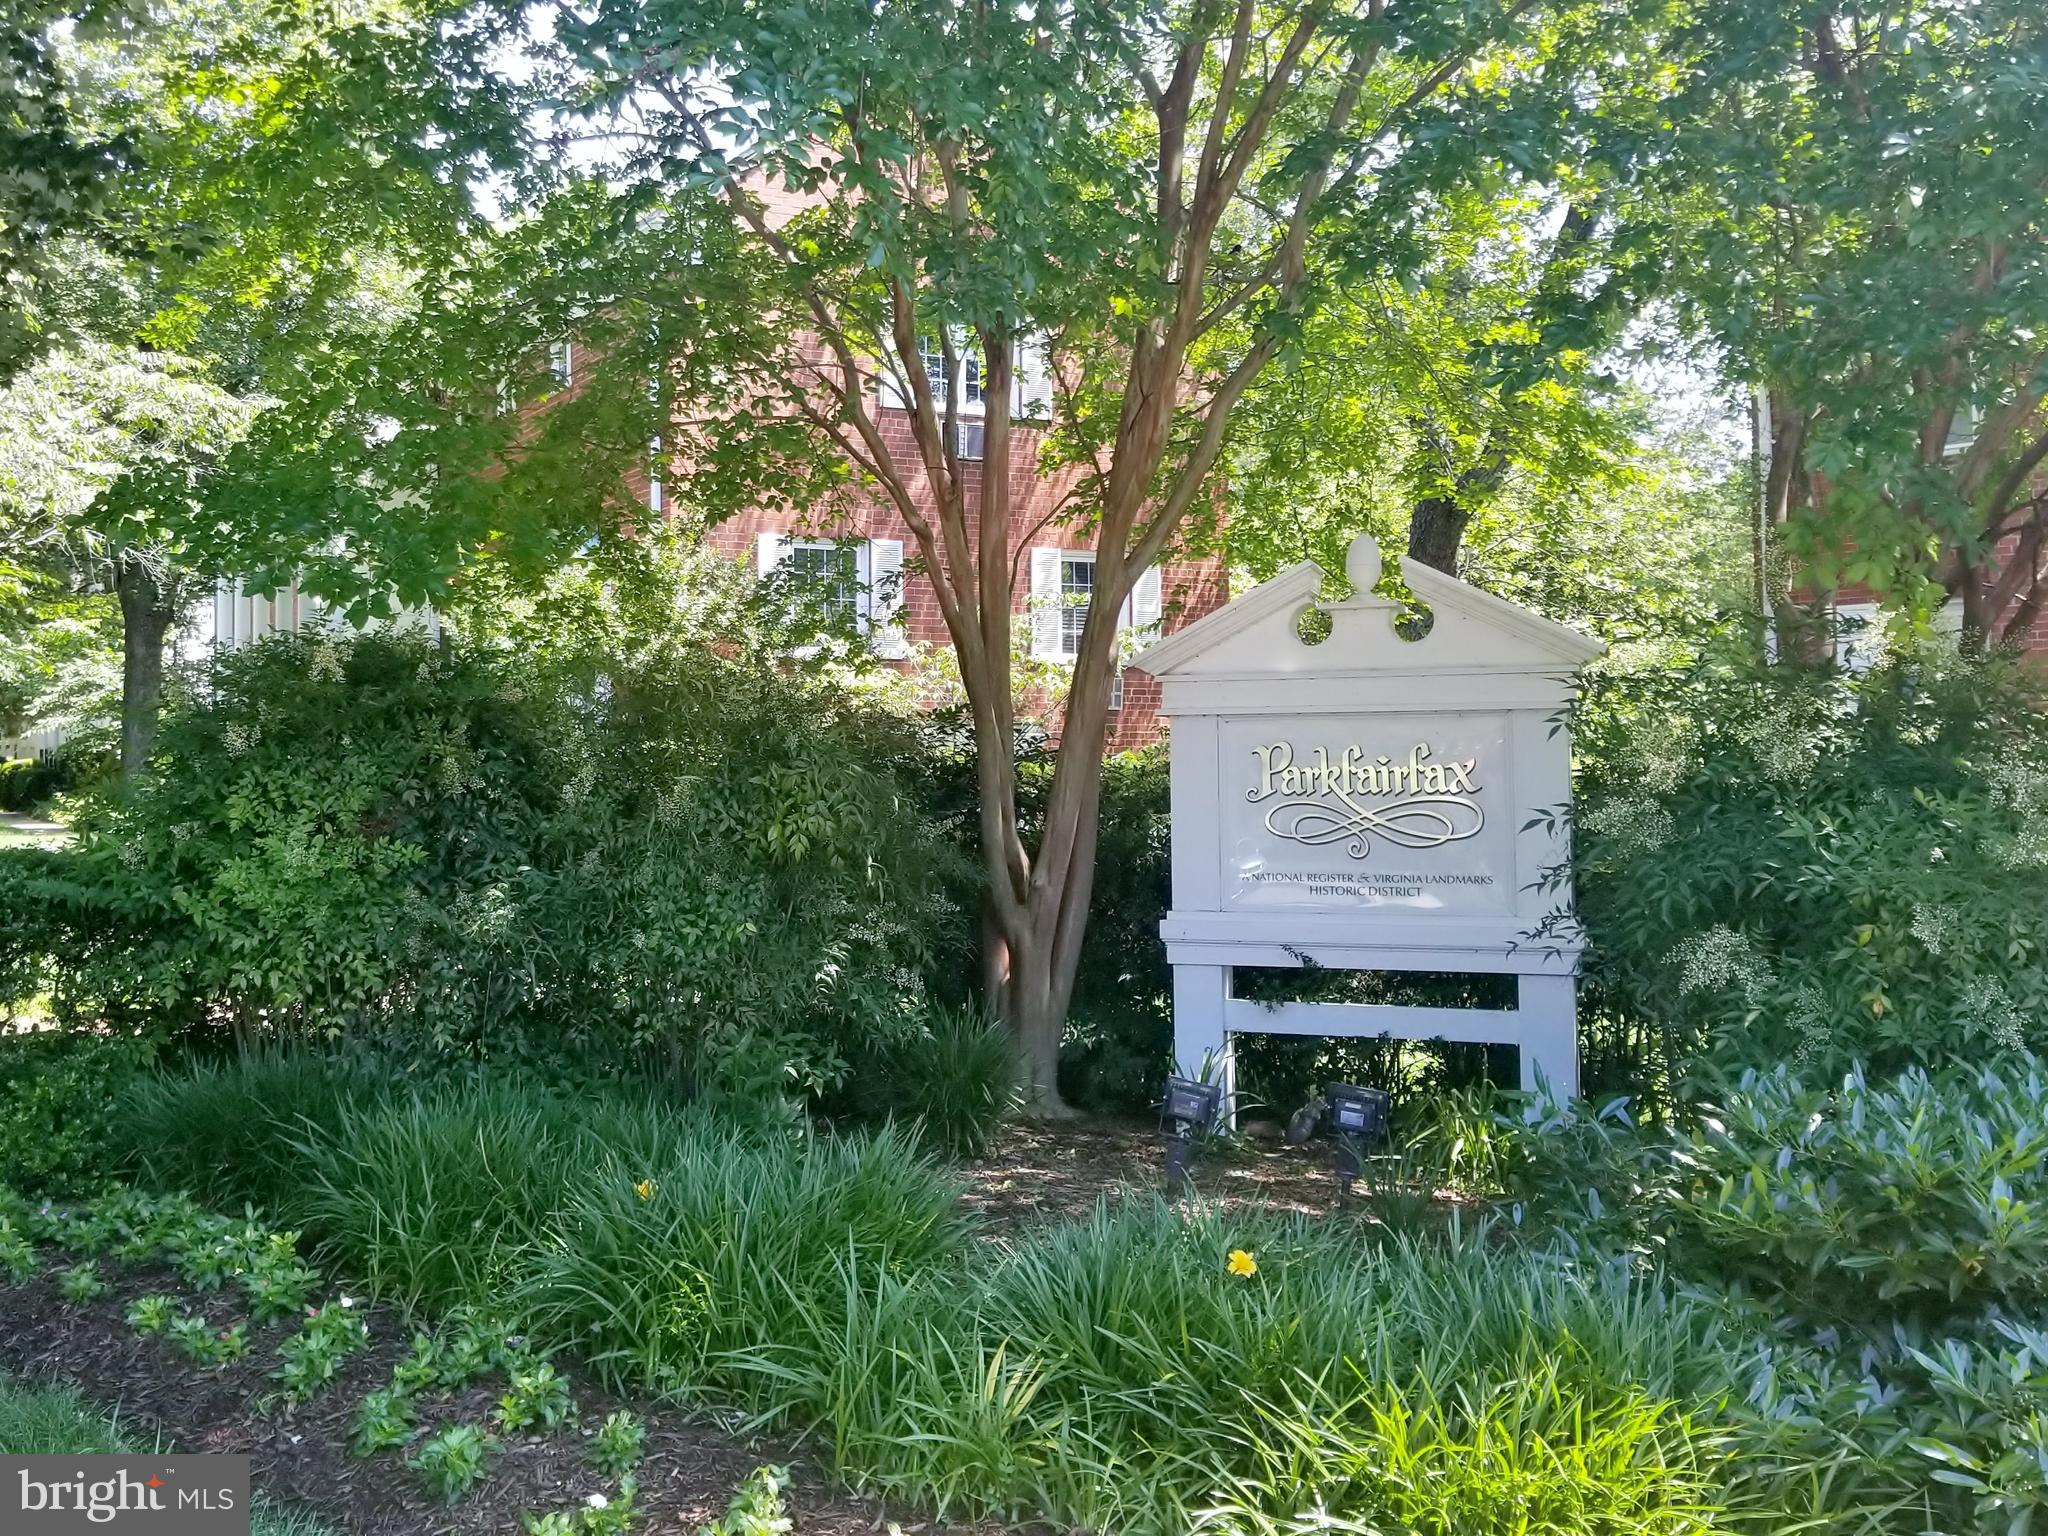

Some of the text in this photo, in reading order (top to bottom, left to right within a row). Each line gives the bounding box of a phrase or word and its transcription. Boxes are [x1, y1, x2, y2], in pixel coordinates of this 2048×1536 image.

[1245, 740, 1482, 803] Parkfairfax
[1252, 872, 1305, 883] NATIONAL
[1307, 873, 1354, 883] REGISTER
[1357, 872, 1370, 884] &
[1373, 874, 1423, 884] VIRGINIA
[1425, 874, 1493, 886] LANDMARKS
[1309, 885, 1422, 897] HISTORIC DISTRICT
